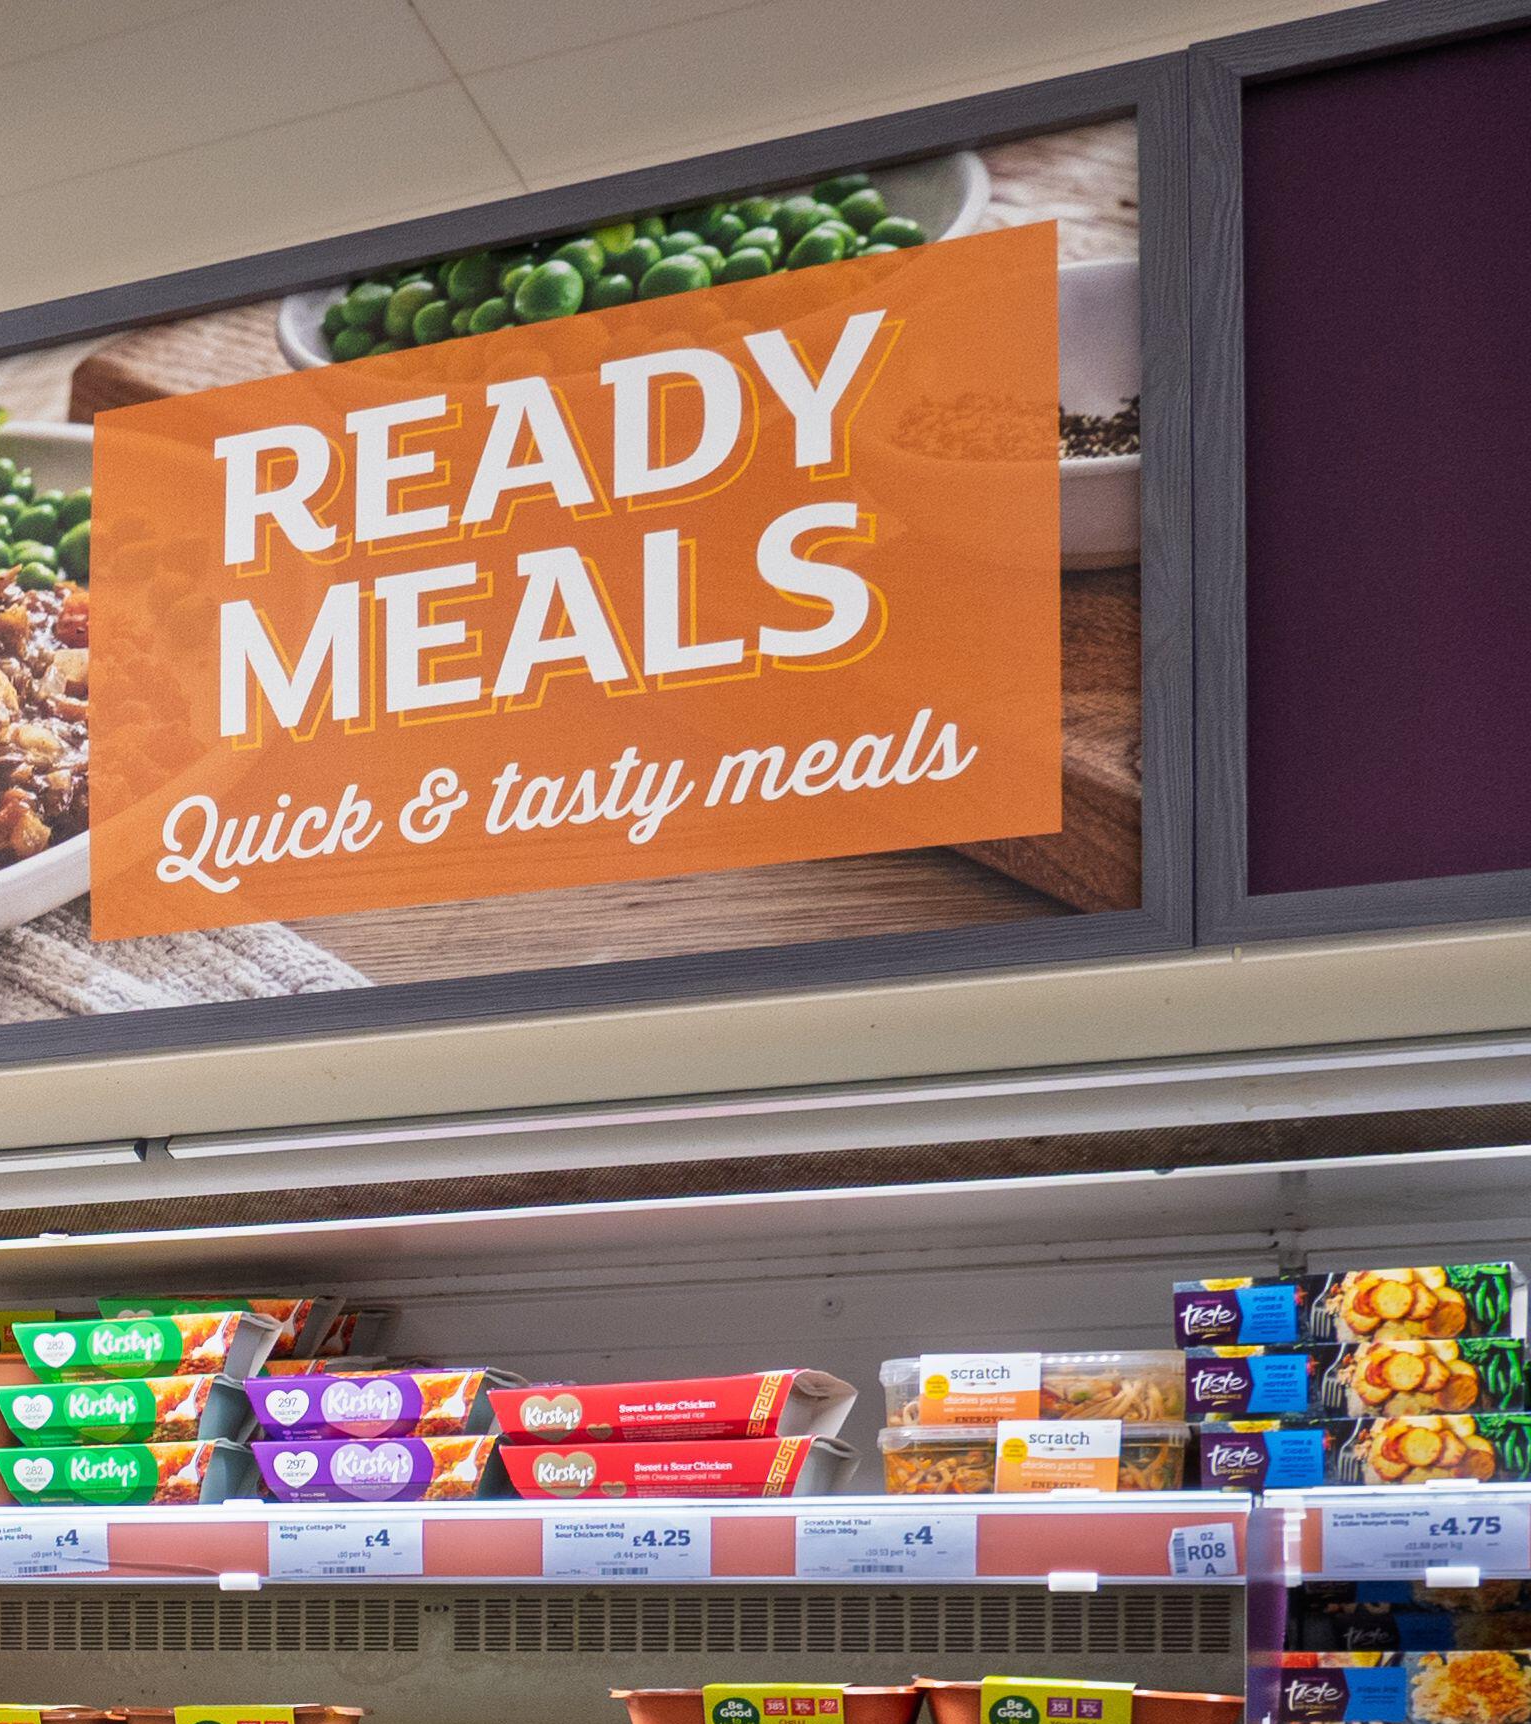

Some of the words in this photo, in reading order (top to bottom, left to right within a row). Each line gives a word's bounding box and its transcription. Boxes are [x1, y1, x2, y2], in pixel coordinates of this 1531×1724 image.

[215, 308, 889, 568] READY
[218, 502, 875, 738] MEALS
[155, 767, 380, 896] Quick
[399, 767, 470, 845] &
[487, 746, 695, 847] tasty
[705, 708, 977, 803] meals
[1181, 1303, 1236, 1326] taste
[46, 1339, 65, 1351] 282
[92, 1327, 165, 1355] Kirsty's
[950, 1365, 1010, 1381] scratch
[1191, 1371, 1248, 1396] taste
[69, 1393, 137, 1420] Kirsty's
[277, 1396, 299, 1409] 297
[328, 1386, 403, 1420] Kirsty's
[619, 1404, 645, 1413] Sweet
[655, 1402, 675, 1411] Sour
[677, 1400, 715, 1410] Chicken
[524, 1406, 580, 1431] Kirsty's
[1028, 1431, 1090, 1446] scratch
[25, 1465, 43, 1476] 282
[70, 1457, 138, 1483] Kirsty's
[285, 1458, 307, 1471] 297
[337, 1451, 411, 1483] Kirsty's
[537, 1463, 594, 1487] Kirsty's
[1429, 1516, 1501, 1536] £4.75
[56, 1529, 79, 1548] £4
[365, 1529, 390, 1549] £4
[632, 1529, 691, 1548] £4.25
[903, 1526, 934, 1548] £4
[1188, 1543, 1226, 1560] R08
[1205, 1564, 1216, 1576] A
